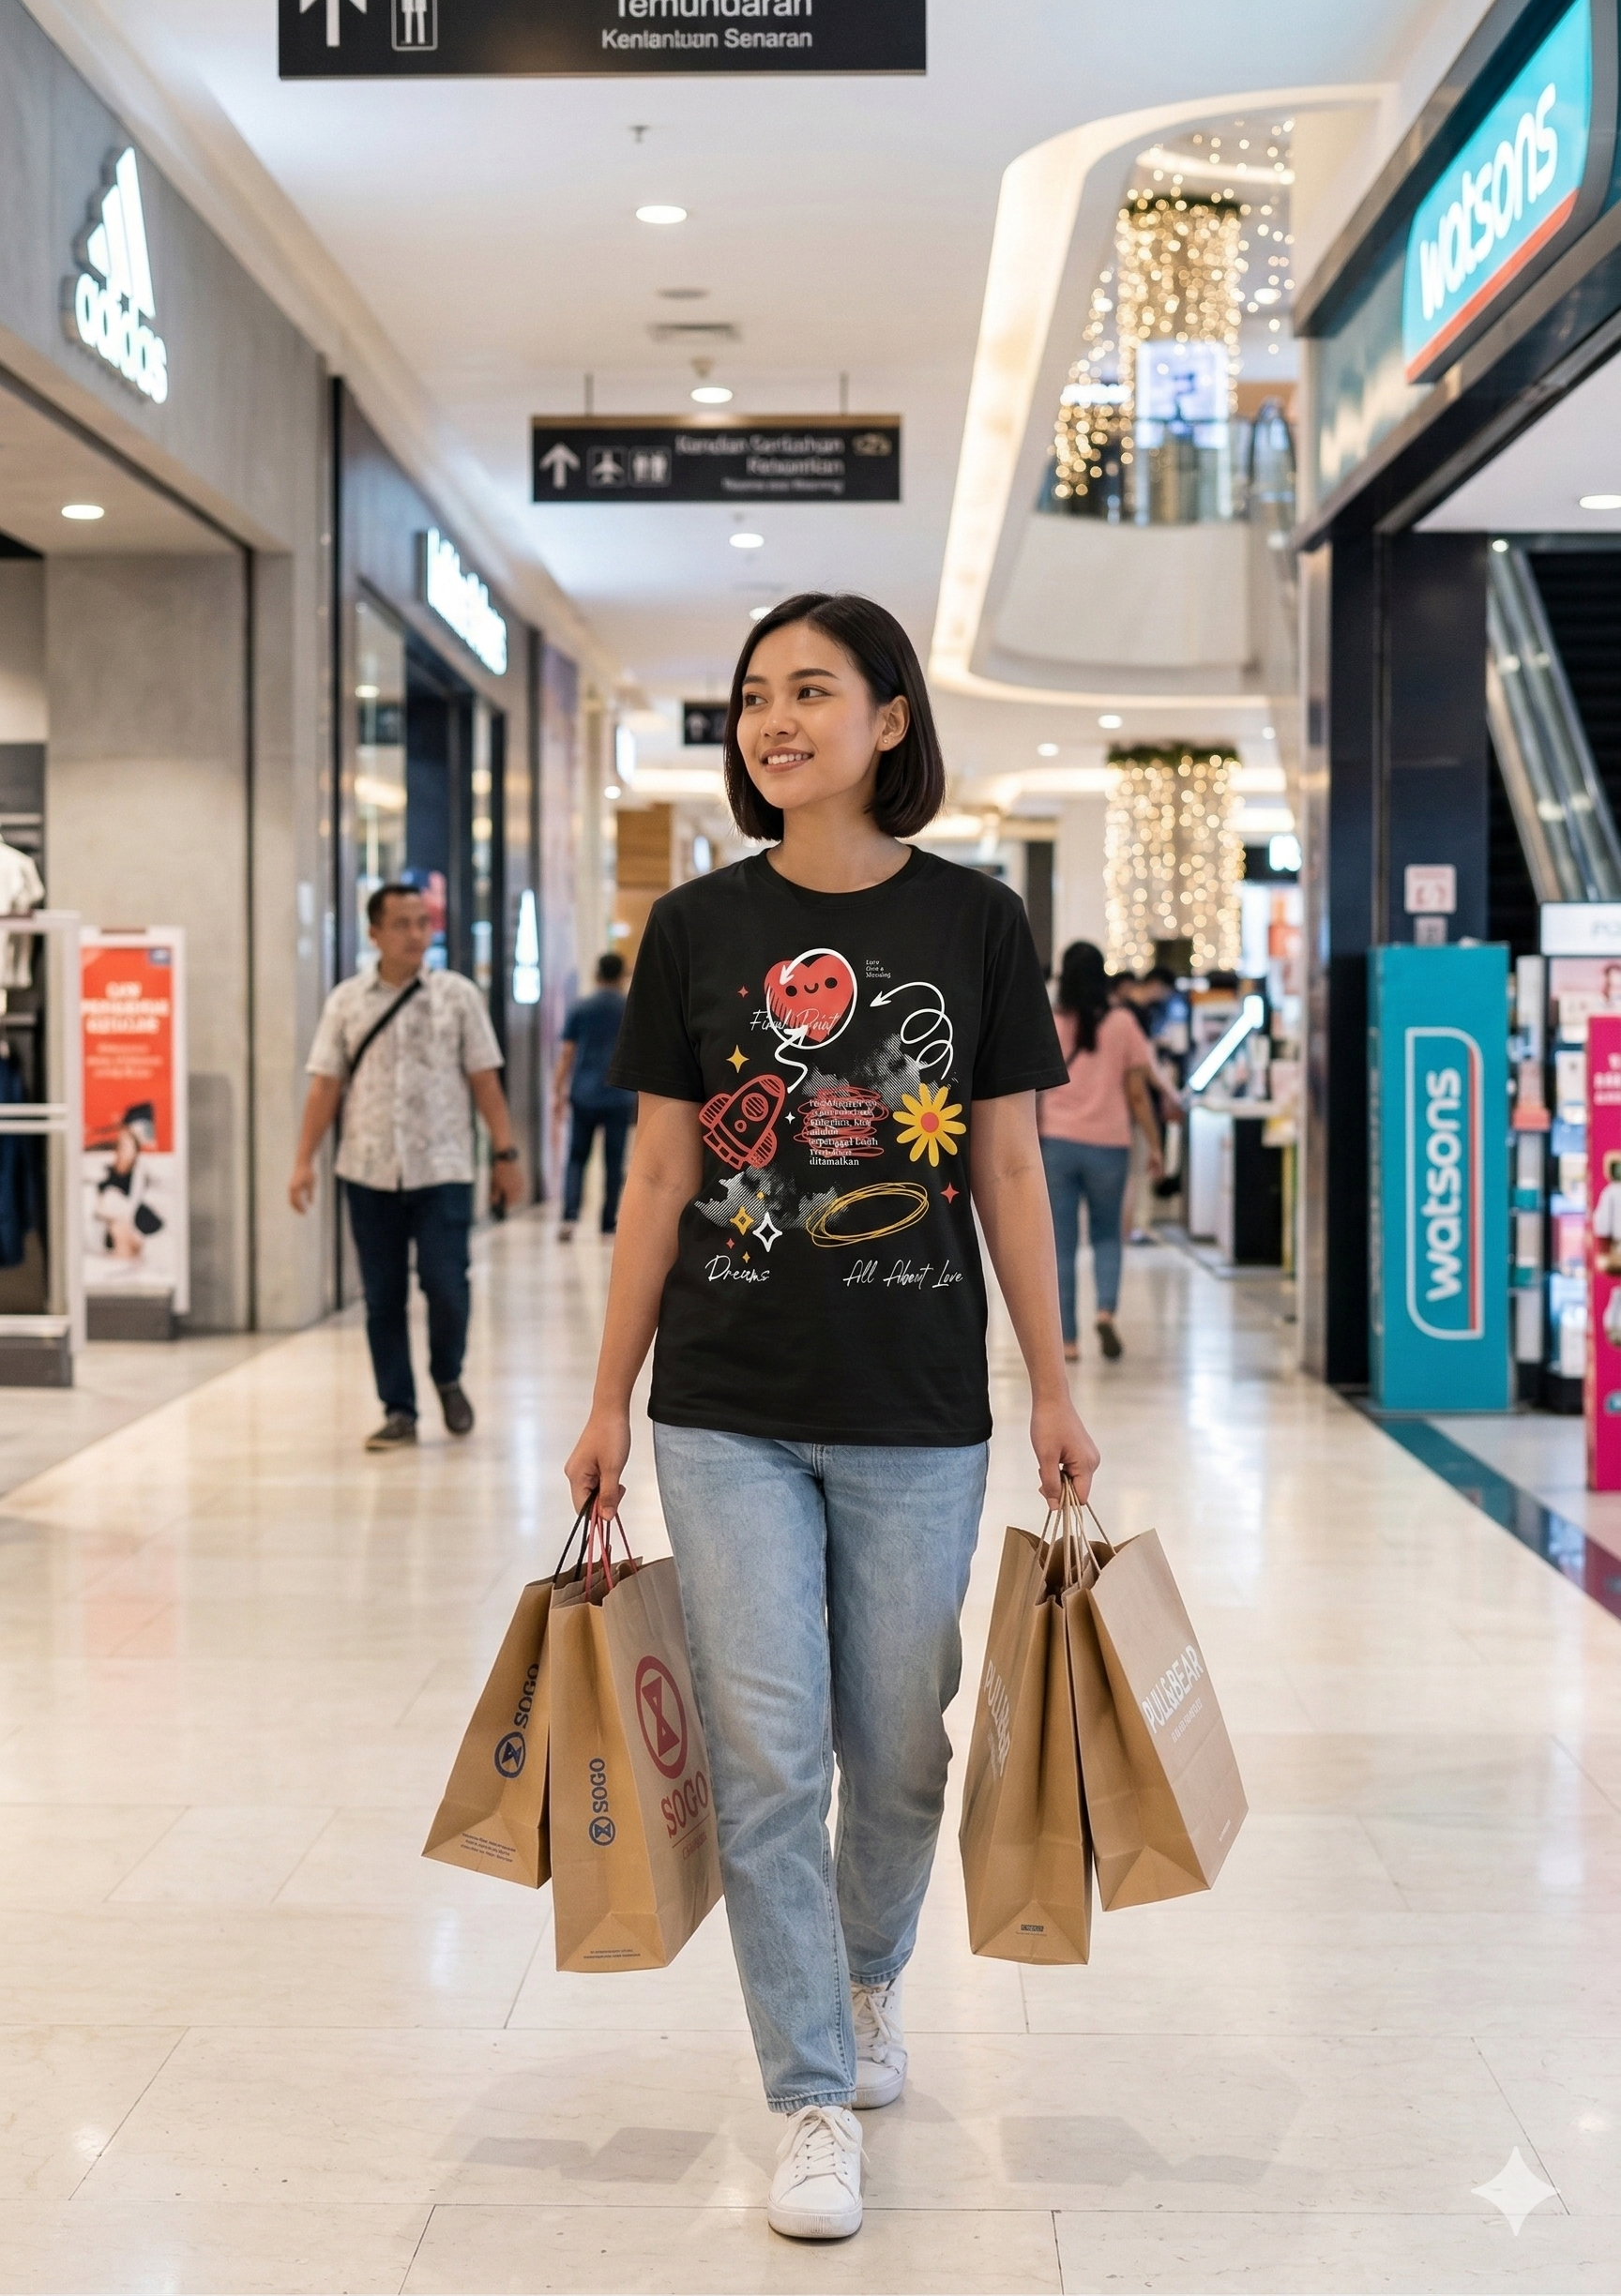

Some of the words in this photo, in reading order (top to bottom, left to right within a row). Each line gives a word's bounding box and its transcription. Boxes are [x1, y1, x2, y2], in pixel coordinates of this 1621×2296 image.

[724, 27, 813, 48] Senaran
[1420, 83, 1558, 321] watsons
[75, 272, 168, 404] adidas
[1420, 1067, 1462, 1302] watsons
[704, 1255, 770, 1283] Dreams
[842, 1260, 879, 1287] All
[932, 1260, 963, 1288] Love
[513, 1663, 539, 1730] SOGO
[1141, 1644, 1204, 1735] PULL&BEAR
[588, 1758, 609, 1814] SOGO
[661, 1771, 708, 1839] SOGO
